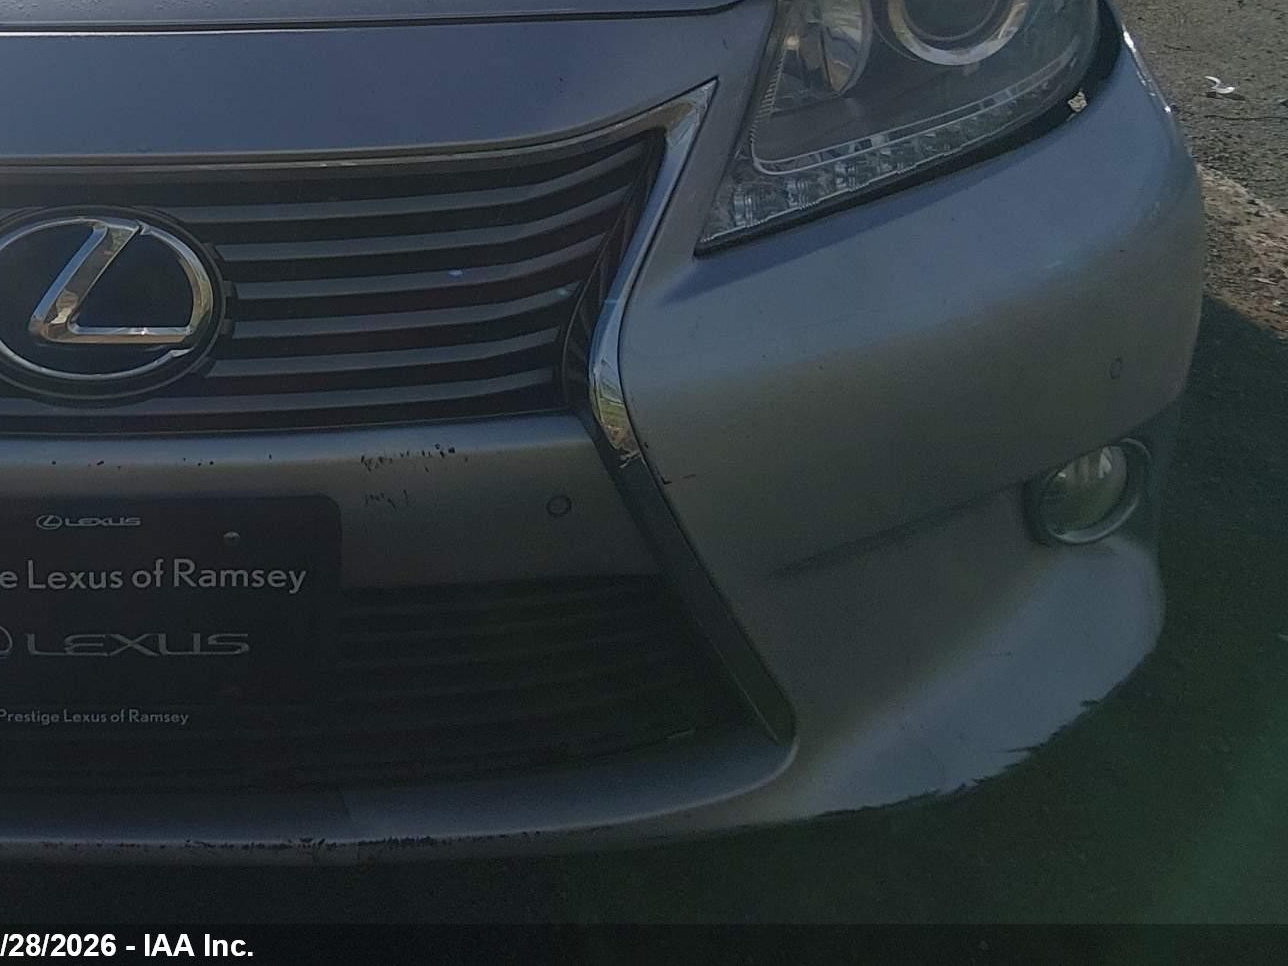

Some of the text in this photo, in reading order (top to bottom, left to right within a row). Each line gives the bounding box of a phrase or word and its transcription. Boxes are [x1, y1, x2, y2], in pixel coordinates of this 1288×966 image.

[64, 515, 142, 527] LEXUS
[27, 559, 123, 590] Lexus
[132, 558, 164, 588] of
[173, 558, 307, 594] Ramsey
[26, 633, 251, 657] LEXUS
[63, 708, 107, 723] Lexus
[110, 708, 125, 723] of
[128, 708, 189, 725] Ramsey
